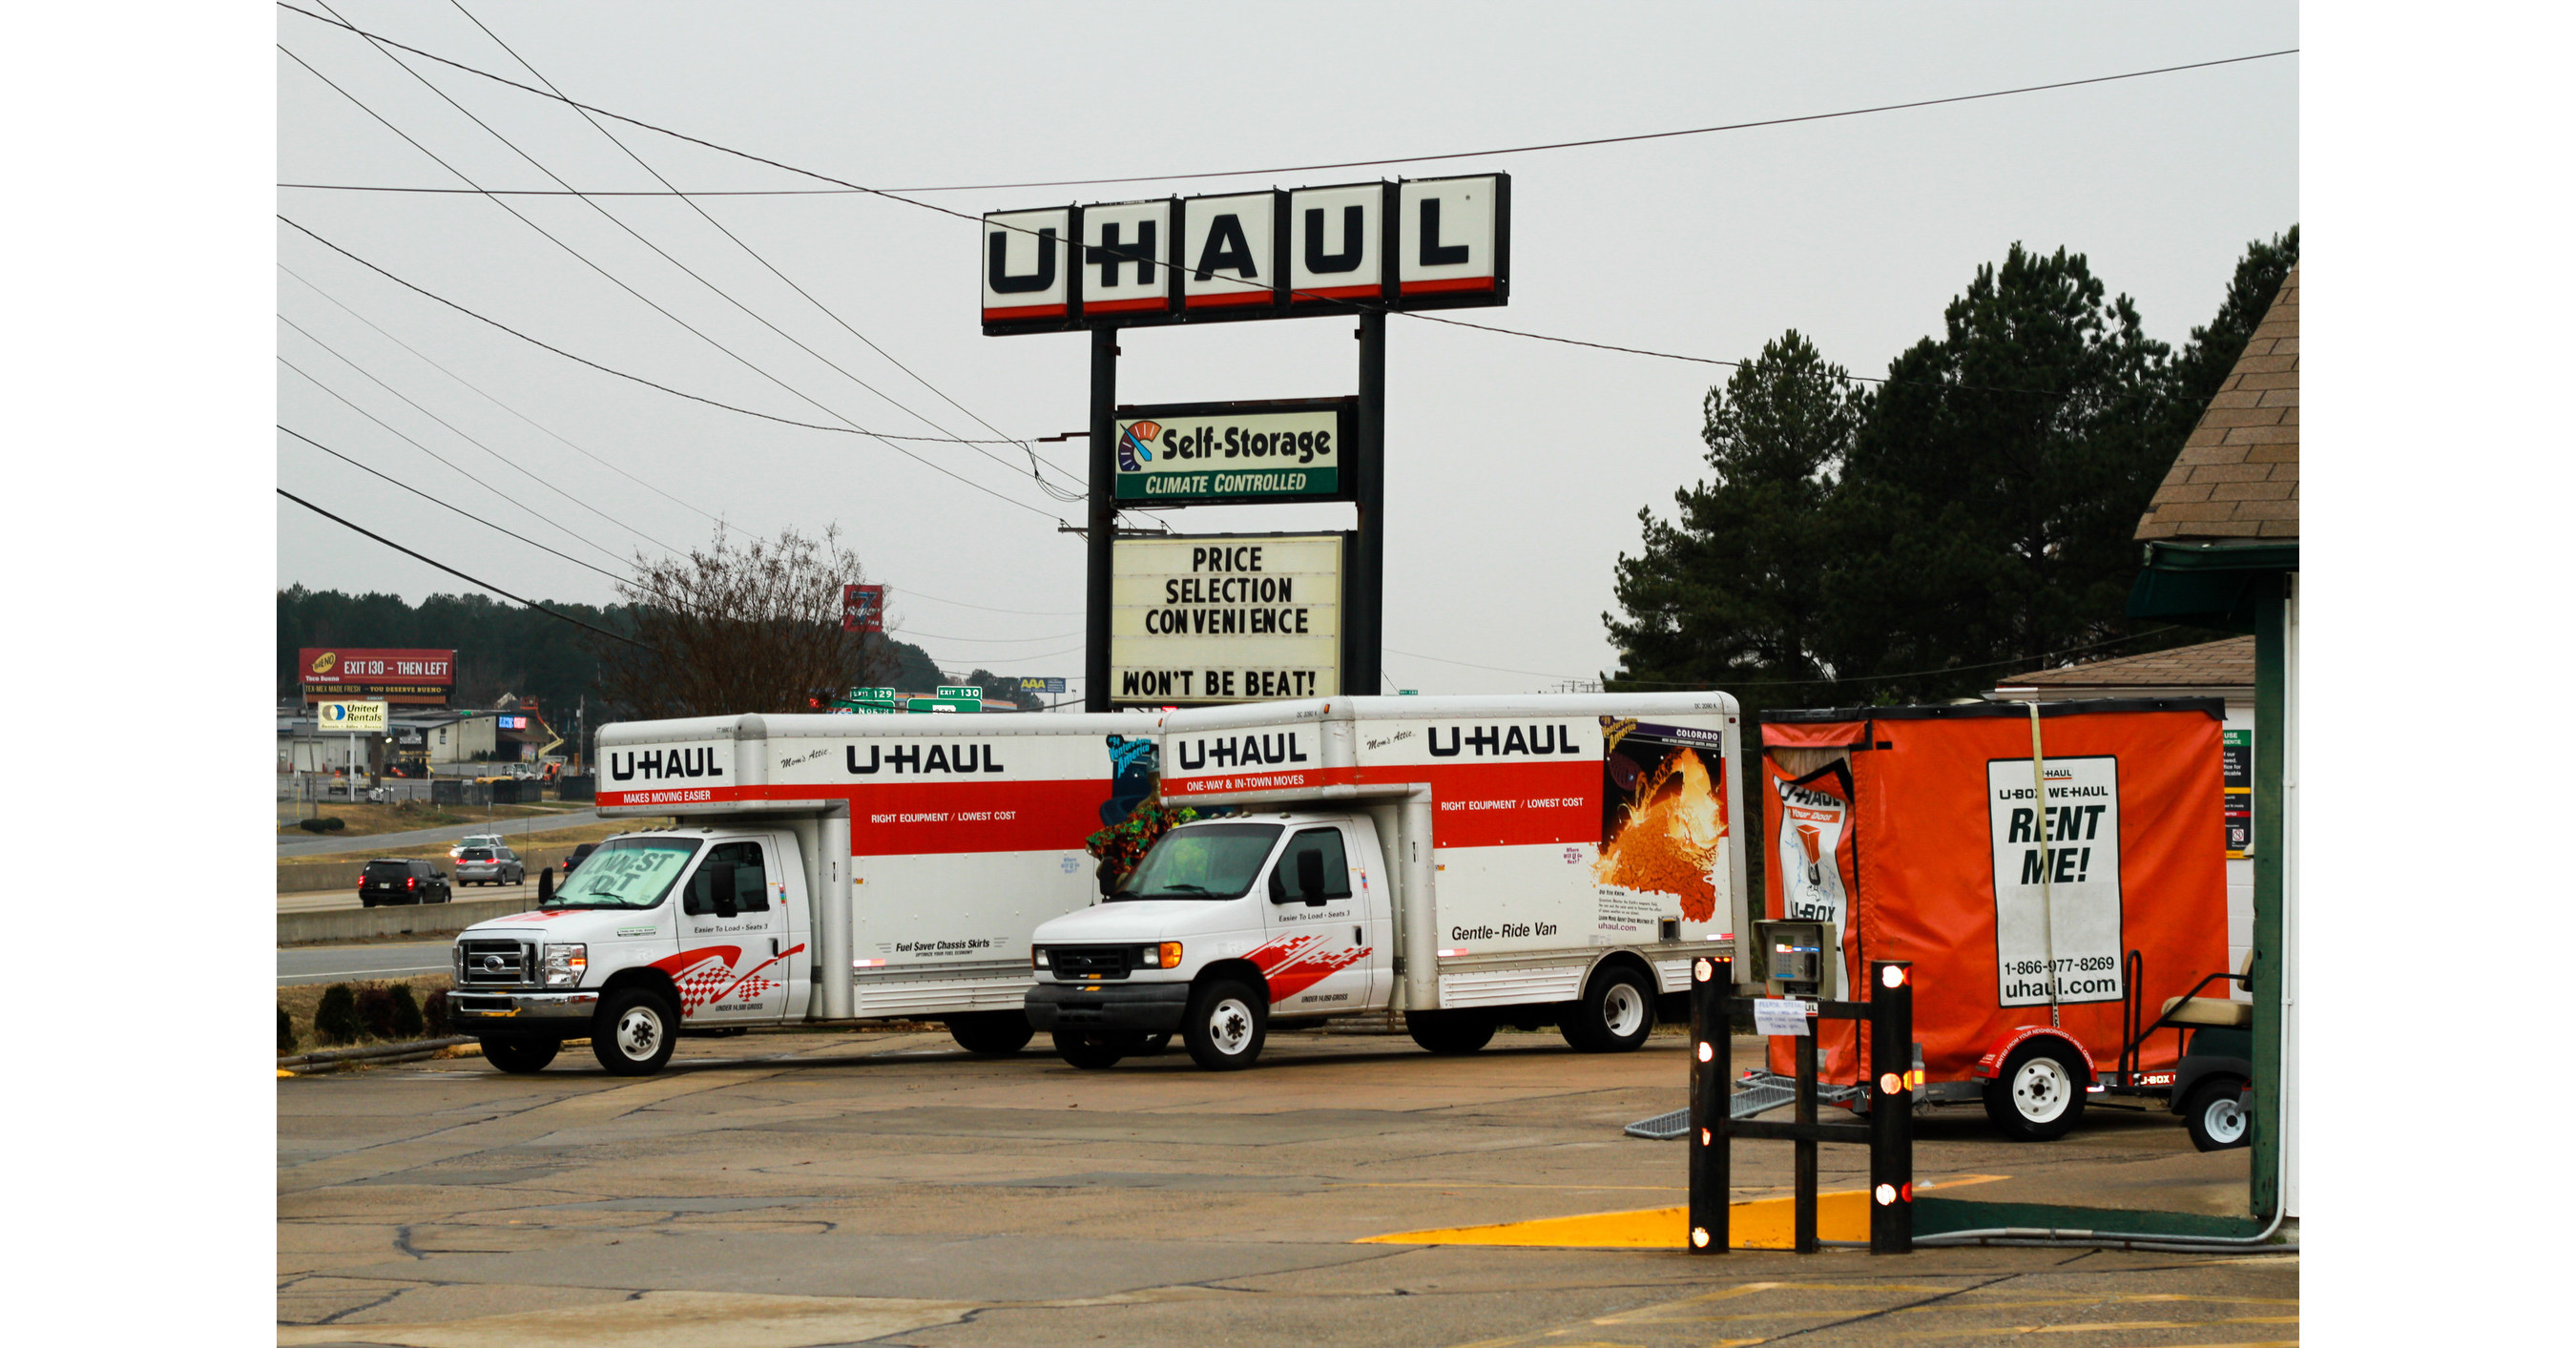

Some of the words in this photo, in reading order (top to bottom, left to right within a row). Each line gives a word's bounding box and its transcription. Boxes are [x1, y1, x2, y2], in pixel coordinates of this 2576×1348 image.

[1162, 426, 1331, 464] Self-Storage
[1146, 475, 1209, 494] CLIMATE
[1214, 473, 1307, 492] CONTROLLED
[1193, 547, 1262, 572] PRICE
[1166, 577, 1292, 604] SELECTION
[1145, 608, 1308, 634] CONVENIENCE
[343, 661, 366, 674] EXIT
[368, 661, 384, 674] 130
[397, 661, 423, 675] THEN
[425, 662, 448, 675] LEFT
[1021, 678, 1047, 689] AAA
[1123, 671, 1194, 696] WON'T
[1205, 671, 1235, 696] BE
[1245, 671, 1316, 696] BEAT!
[873, 690, 893, 698] 129
[346, 704, 379, 713] United
[346, 714, 382, 722] Rentals
[1366, 736, 1391, 750] Mom's
[1393, 730, 1413, 742] Attic
[1428, 724, 1580, 757] U-HAUL
[1676, 729, 1718, 741] COLORADO
[846, 744, 1005, 775] U-HAUL
[1117, 744, 1150, 778] America
[1179, 733, 1307, 770] U-HAUL
[612, 747, 723, 781] U-HAUL
[780, 755, 807, 769] Mom's
[2043, 769, 2072, 778] -HAUL
[1187, 779, 1223, 792] ONE-WAY
[1225, 779, 1233, 789] &
[1235, 777, 1272, 789] IN-TOWN
[1274, 775, 1304, 786] MOVES
[2048, 786, 2109, 798] WE-HAUL
[623, 792, 650, 804] MAKES
[652, 790, 683, 803] MOVING
[684, 790, 711, 801] EASIER
[1442, 801, 1465, 811] RIGHT
[1468, 799, 1516, 810] EQUIPMENT
[1527, 798, 1560, 808] LOWEST
[1562, 798, 1584, 807] COST
[871, 814, 897, 823] RIGHT
[900, 813, 948, 823] EQUIPMENT
[958, 812, 990, 822] LOWEST
[993, 811, 1016, 820] COST
[1792, 808, 1811, 819] Your
[1811, 811, 1833, 821] Door
[2008, 805, 2106, 843] RENT
[2021, 847, 2090, 884] ME!
[1790, 900, 1837, 922] U-BOX
[1534, 922, 1557, 936] Van
[1598, 923, 1637, 931] uhaul.com
[896, 943, 912, 952] Fuel
[914, 942, 935, 951] Saver
[937, 940, 966, 950] Chassis
[967, 939, 990, 948] Skirts
[2005, 956, 2115, 975] 1-866-977-8269
[2005, 978, 2116, 998] uhaul.com
[1995, 1048, 2008, 1068] RENTED
[2006, 1037, 2019, 1050] FROM
[2019, 1030, 2032, 1040] YOUR
[2032, 1027, 2069, 1039] NEIGHBORHOOD
[2082, 1049, 2095, 1069] CENTER
